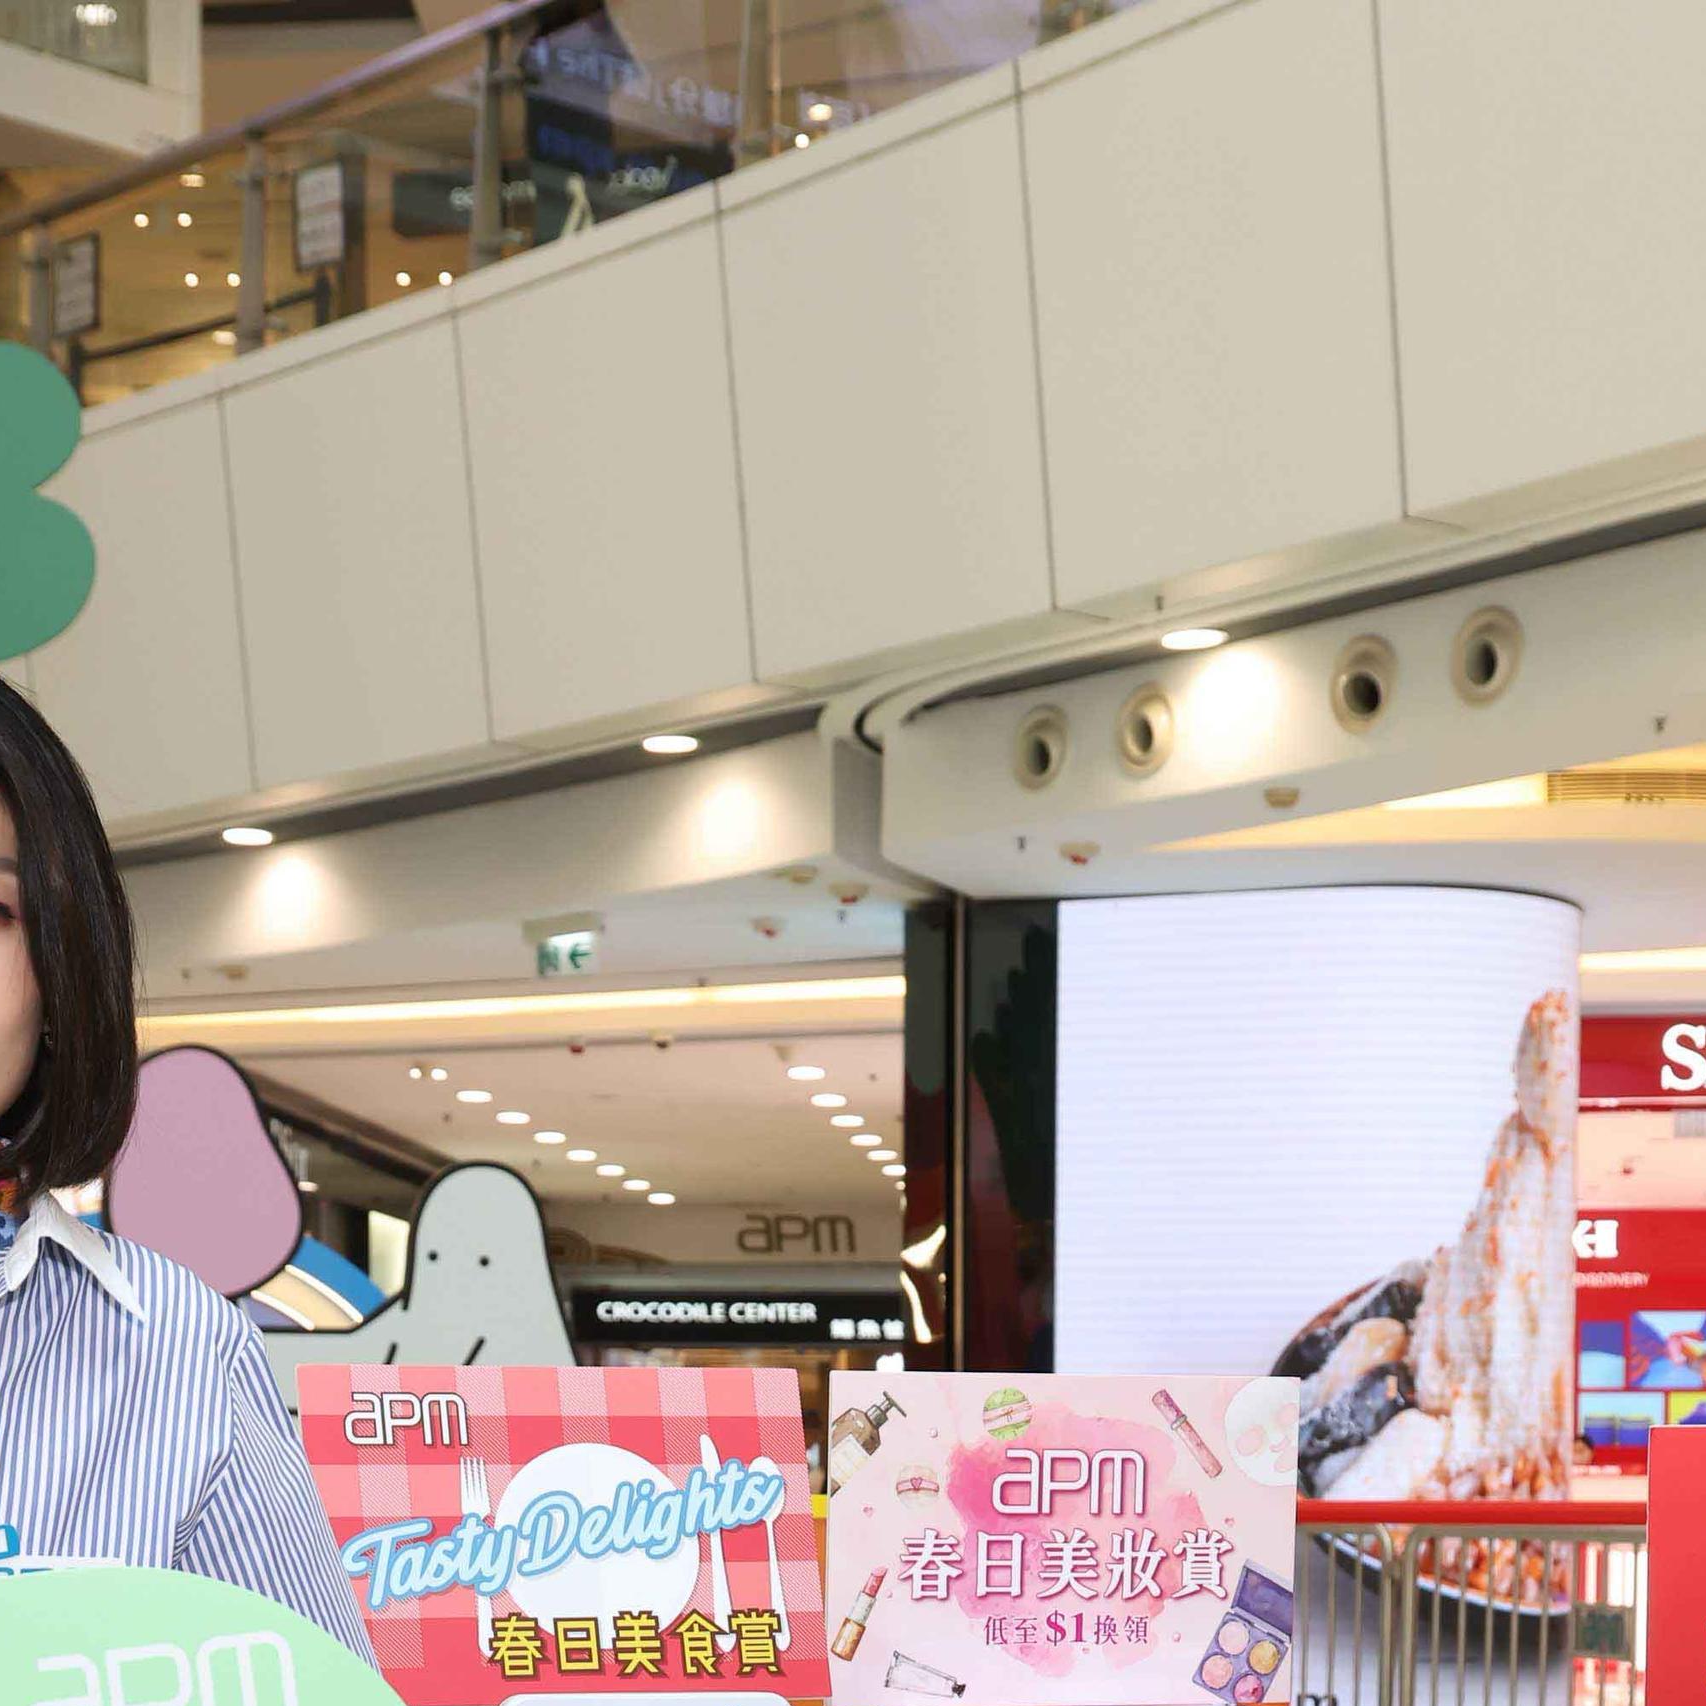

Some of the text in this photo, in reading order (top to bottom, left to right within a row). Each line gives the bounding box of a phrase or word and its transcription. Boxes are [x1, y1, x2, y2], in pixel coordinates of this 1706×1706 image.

[737, 1213, 857, 1253] apm
[596, 1301, 818, 1324] CROCODILE CENTER
[343, 1391, 470, 1447] apm
[992, 1448, 1145, 1516] apm
[342, 1458, 785, 1611] Tasty Delights
[899, 1527, 1234, 1599] 春日美妝賞
[489, 1608, 785, 1678] 春日美食賞
